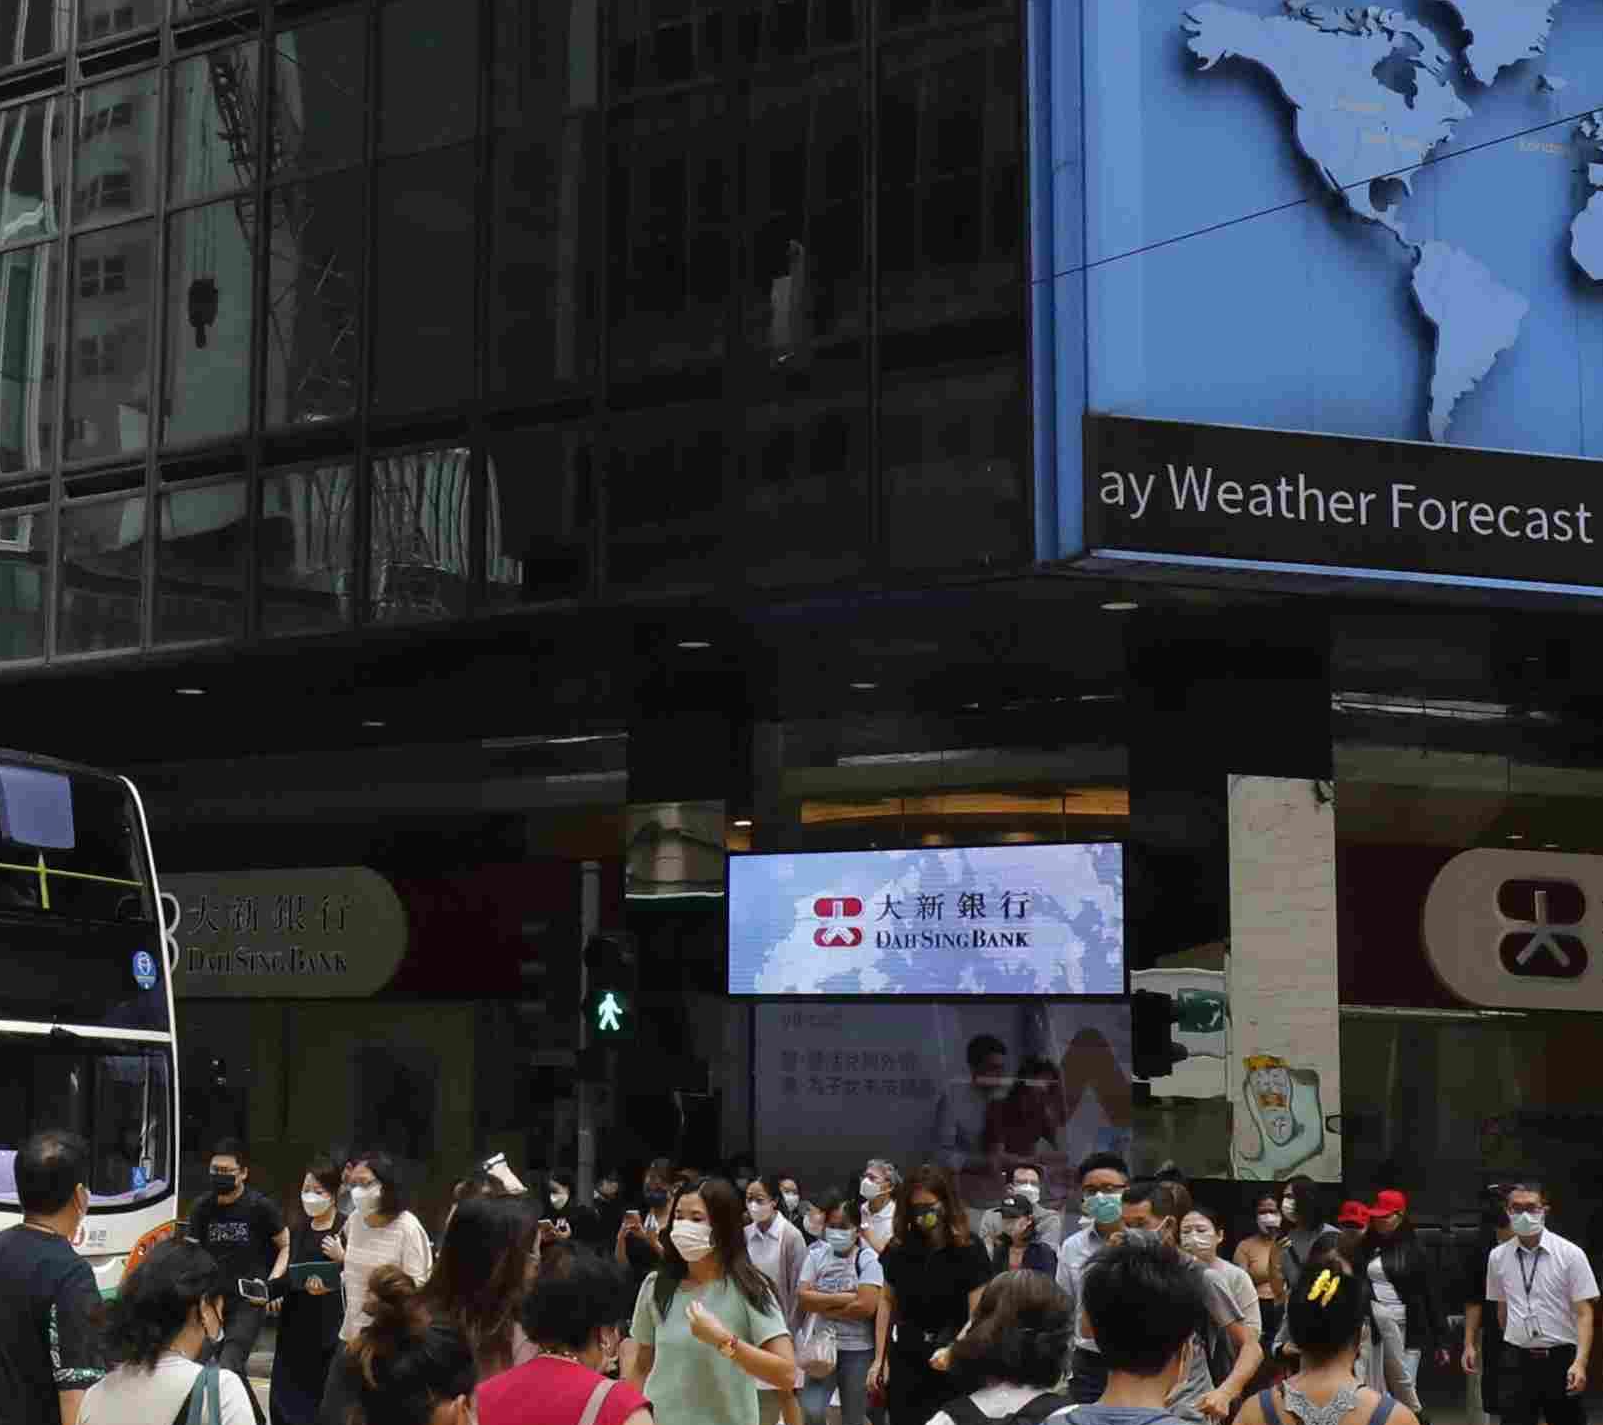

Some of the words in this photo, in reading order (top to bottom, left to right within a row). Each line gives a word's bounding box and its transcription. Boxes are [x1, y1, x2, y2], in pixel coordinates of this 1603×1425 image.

[1168, 463, 1377, 526] Weather
[1391, 482, 1595, 545] Forecast
[185, 894, 355, 936] 大新銀行
[874, 889, 1032, 922] 大新銀行
